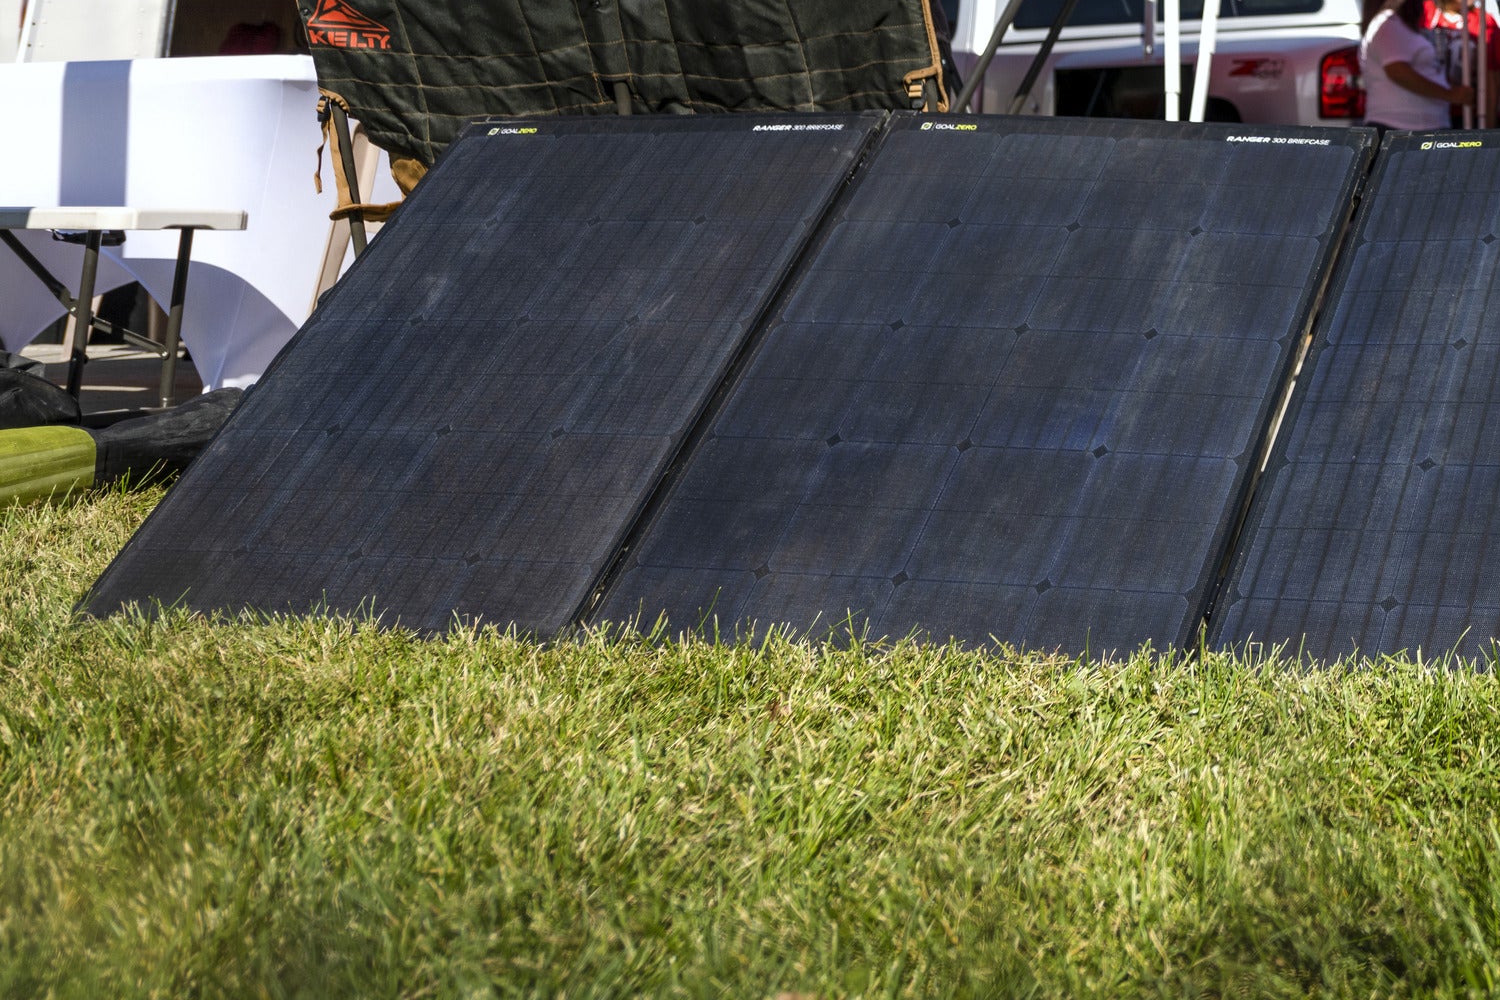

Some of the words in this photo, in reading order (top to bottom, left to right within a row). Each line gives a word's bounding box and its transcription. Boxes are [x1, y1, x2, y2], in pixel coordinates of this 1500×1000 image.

[308, 29, 391, 49] KELTY
[1226, 135, 1272, 143] RANGER
[1286, 137, 1331, 146] BRIEFCASE
